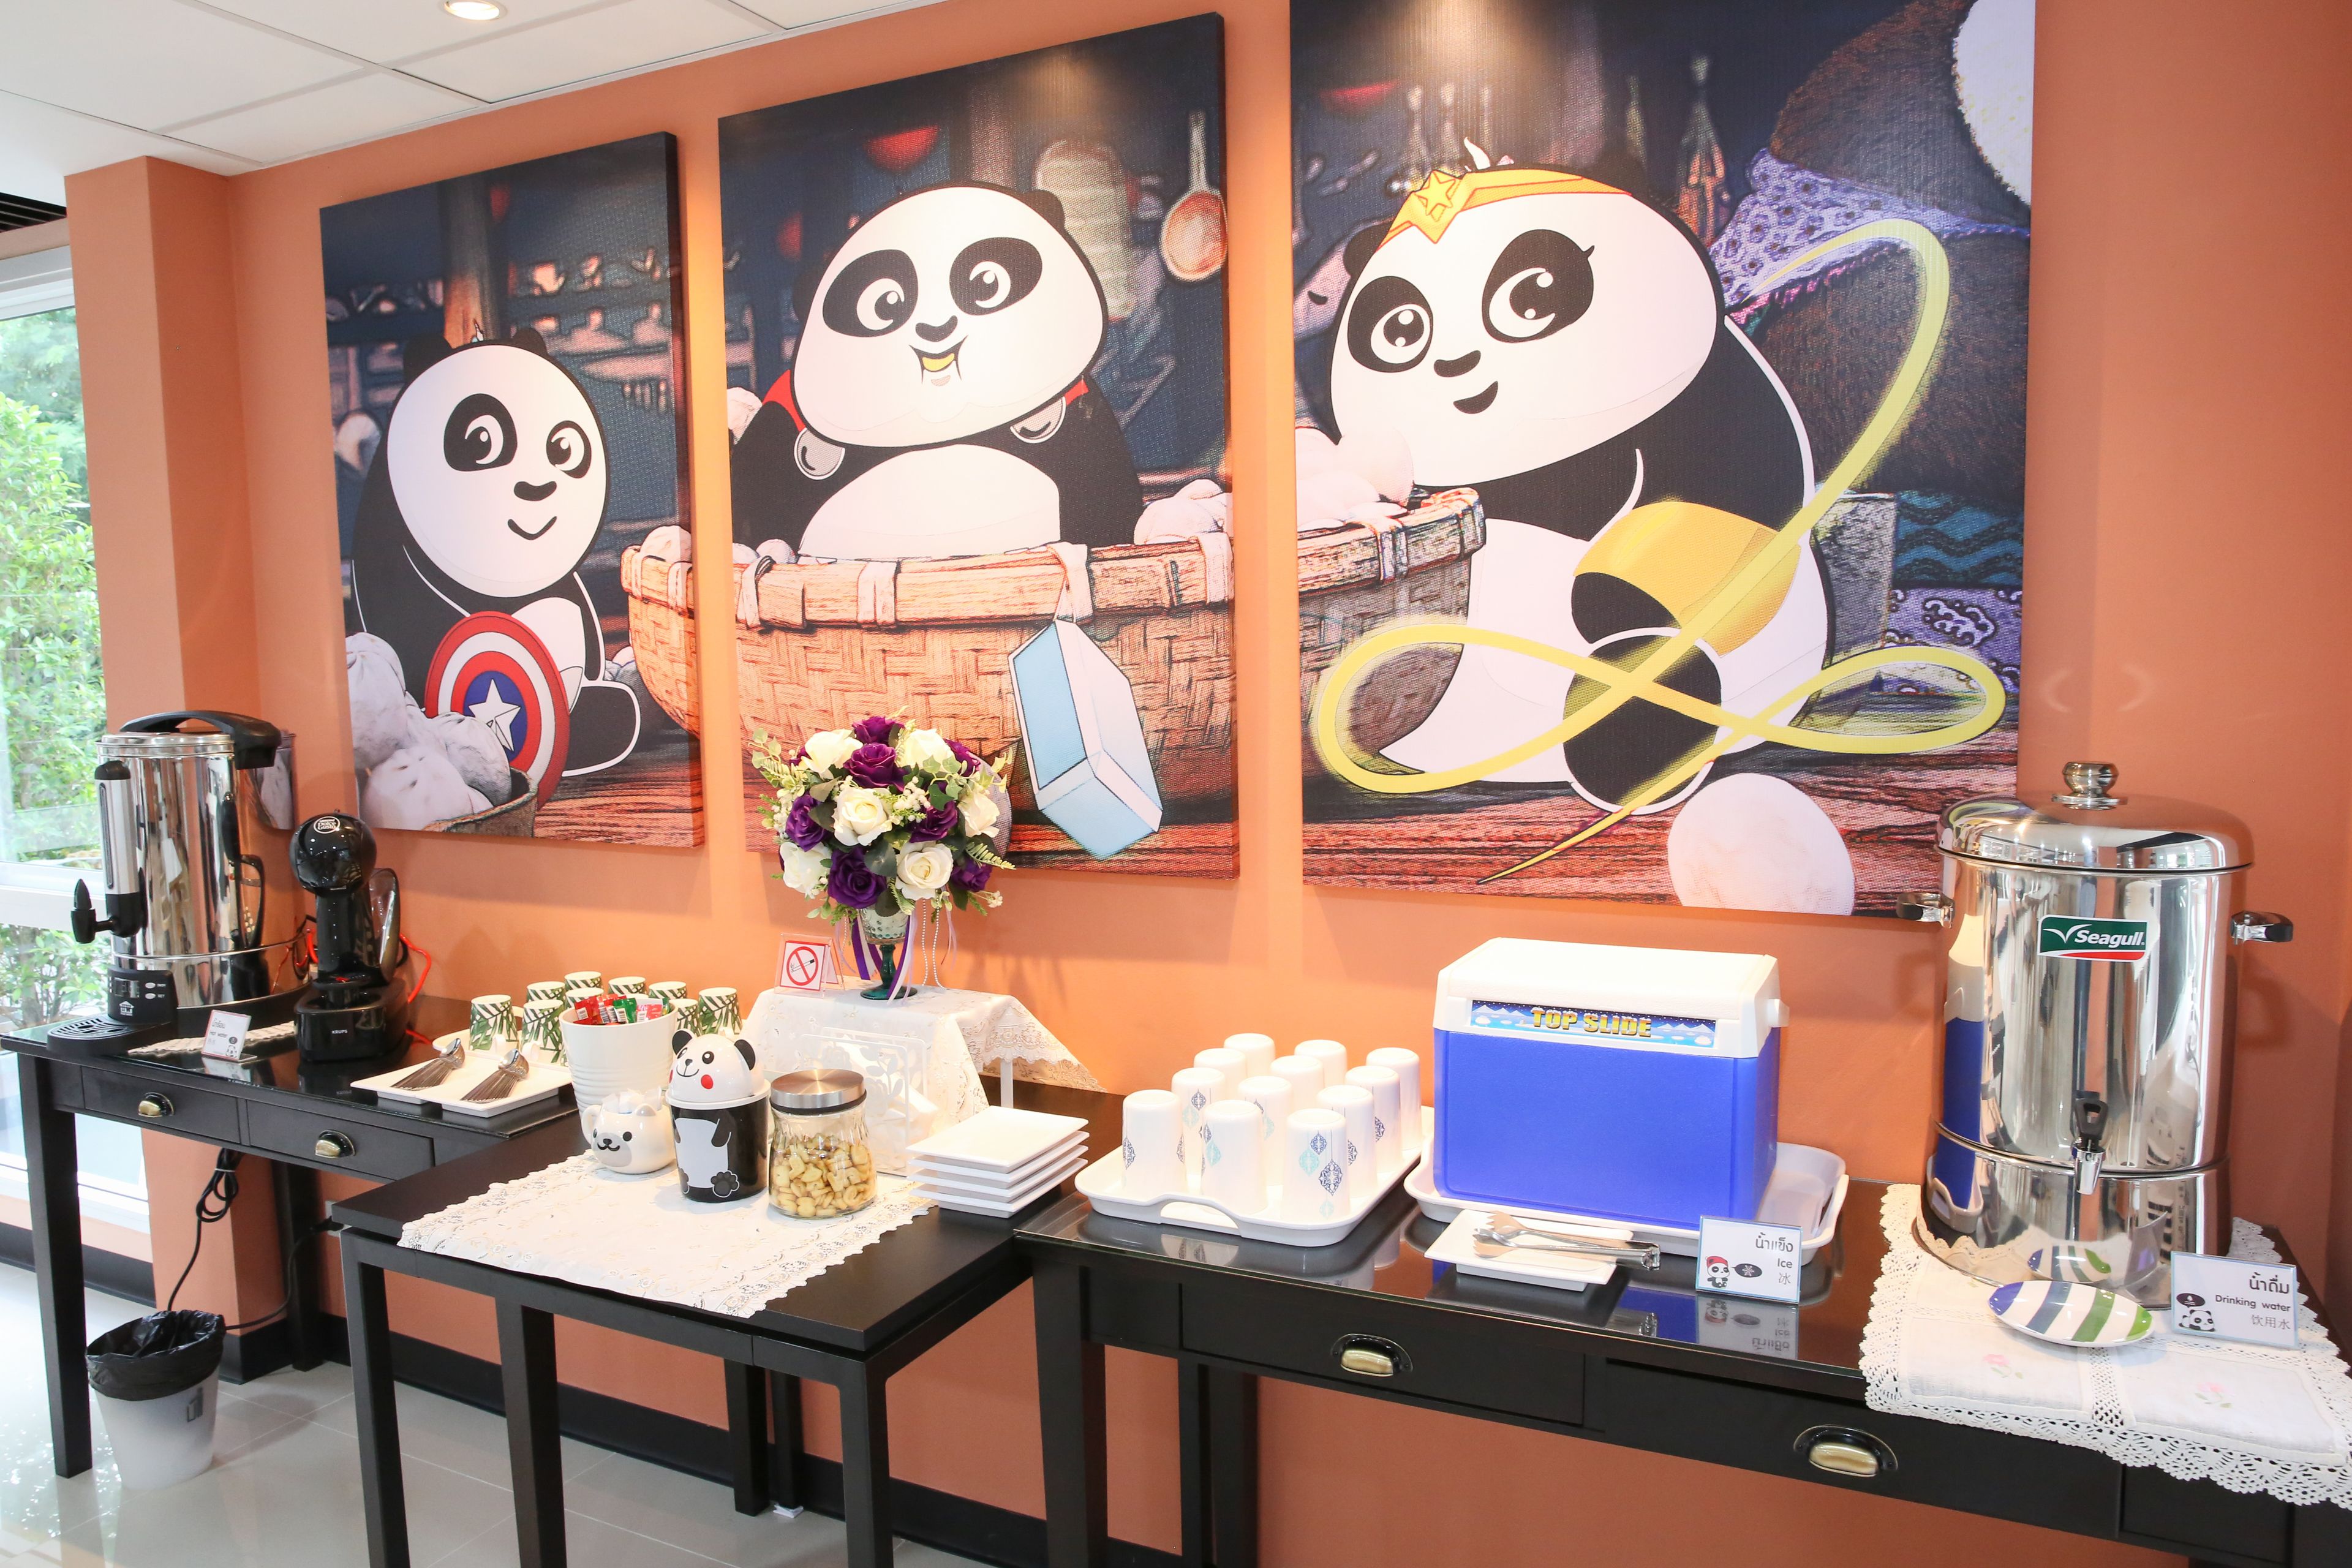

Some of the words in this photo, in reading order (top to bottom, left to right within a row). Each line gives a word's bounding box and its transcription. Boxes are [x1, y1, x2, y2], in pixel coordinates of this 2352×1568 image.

[2074, 929, 2144, 949] Seagull
[1531, 1006, 1578, 1030] TOP
[1583, 1012, 1653, 1038] SLIDE
[1755, 1232, 1794, 1253] น้ำแข็ง
[1777, 1258, 1793, 1268] Ice
[1778, 1272, 1791, 1285] 冰
[2249, 1272, 2290, 1294] น้ำดื่ม
[2215, 1294, 2256, 1309] Drinking
[2261, 1301, 2291, 1312] water
[2252, 1314, 2291, 1330] 饮用水
